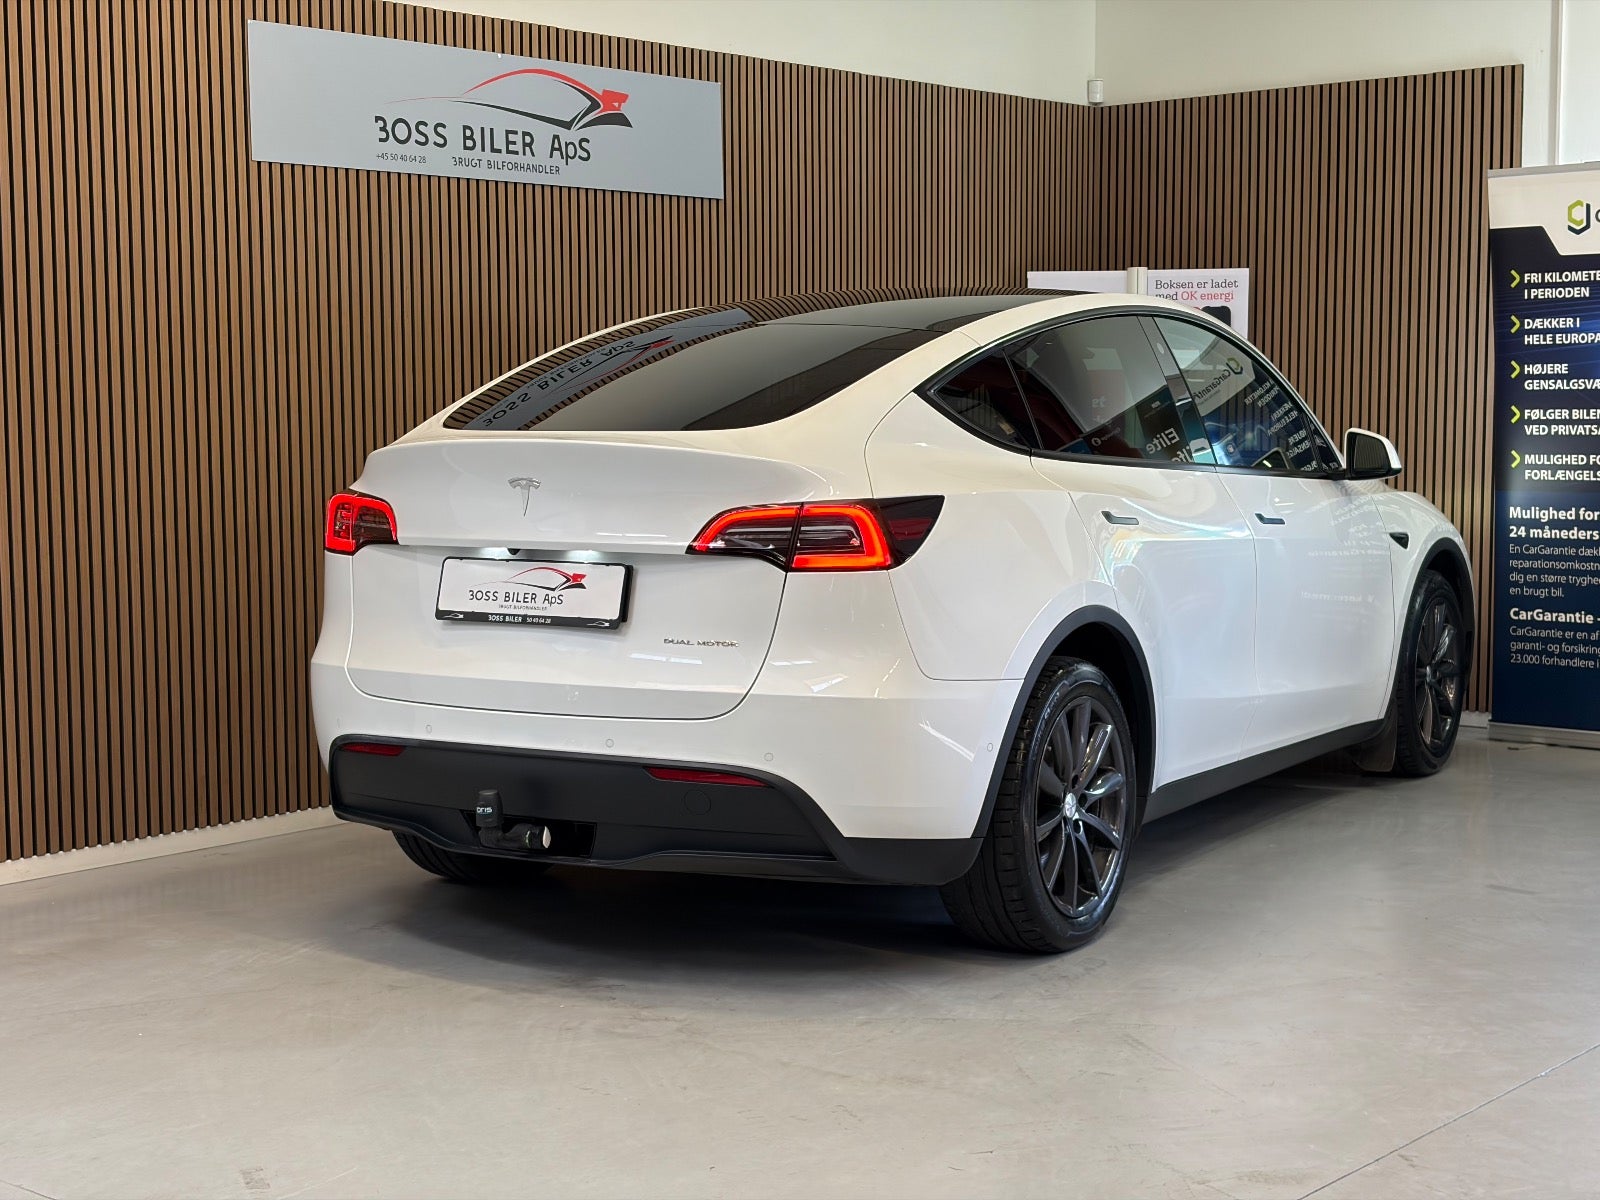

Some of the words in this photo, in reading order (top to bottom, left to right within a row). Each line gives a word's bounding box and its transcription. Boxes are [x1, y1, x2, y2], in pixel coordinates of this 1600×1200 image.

[462, 125, 536, 157] BILER
[549, 134, 591, 165] ApS
[376, 152, 389, 161] +45
[390, 153, 399, 162] 50
[399, 154, 408, 162] 40
[408, 155, 417, 163] 64
[418, 156, 427, 164] 28
[487, 159, 560, 176] BILFORHANDLER
[1155, 279, 1194, 290] Boksen
[1196, 281, 1208, 289] er
[1211, 278, 1239, 289] ladet
[1524, 272, 1542, 284] FRI
[1181, 291, 1198, 301] OK
[1200, 290, 1234, 303] energi
[1524, 289, 1528, 300] I
[1530, 286, 1590, 299] PERIODEN
[1524, 317, 1574, 329] DÆKKER
[1576, 317, 1580, 328] I
[1524, 334, 1553, 345] HELE
[1524, 363, 1569, 375] HØJERE
[1524, 409, 1570, 420] FØLGER
[1524, 425, 1549, 436] VED
[1524, 454, 1587, 465] MULIGHED
[1509, 506, 1576, 523] Mulighed
[1579, 507, 1600, 521] for
[1509, 526, 1526, 538] 24
[1530, 526, 1600, 540] måneders
[1509, 544, 1520, 554] En
[1522, 544, 1577, 556] CarGarantie
[1509, 571, 1524, 584] dig
[1526, 574, 1538, 582] en
[1541, 574, 1567, 583] større
[1509, 587, 1521, 595] en
[1523, 586, 1549, 599] brugt
[1551, 587, 1565, 597] bil.
[504, 592, 537, 604] BILER
[542, 593, 564, 607] ApS
[505, 615, 522, 623] BILER
[1509, 607, 1594, 624] CarGarantie
[1509, 626, 1563, 639] CarGarantie
[1565, 630, 1575, 639] er
[1576, 631, 1588, 640] en
[1590, 630, 1600, 641] af
[697, 640, 739, 648] MOTOR
[1510, 641, 1546, 652] garanti-
[1547, 643, 1560, 655] og
[1510, 653, 1540, 664] 23.000
[1542, 655, 1595, 669] forhandlere
